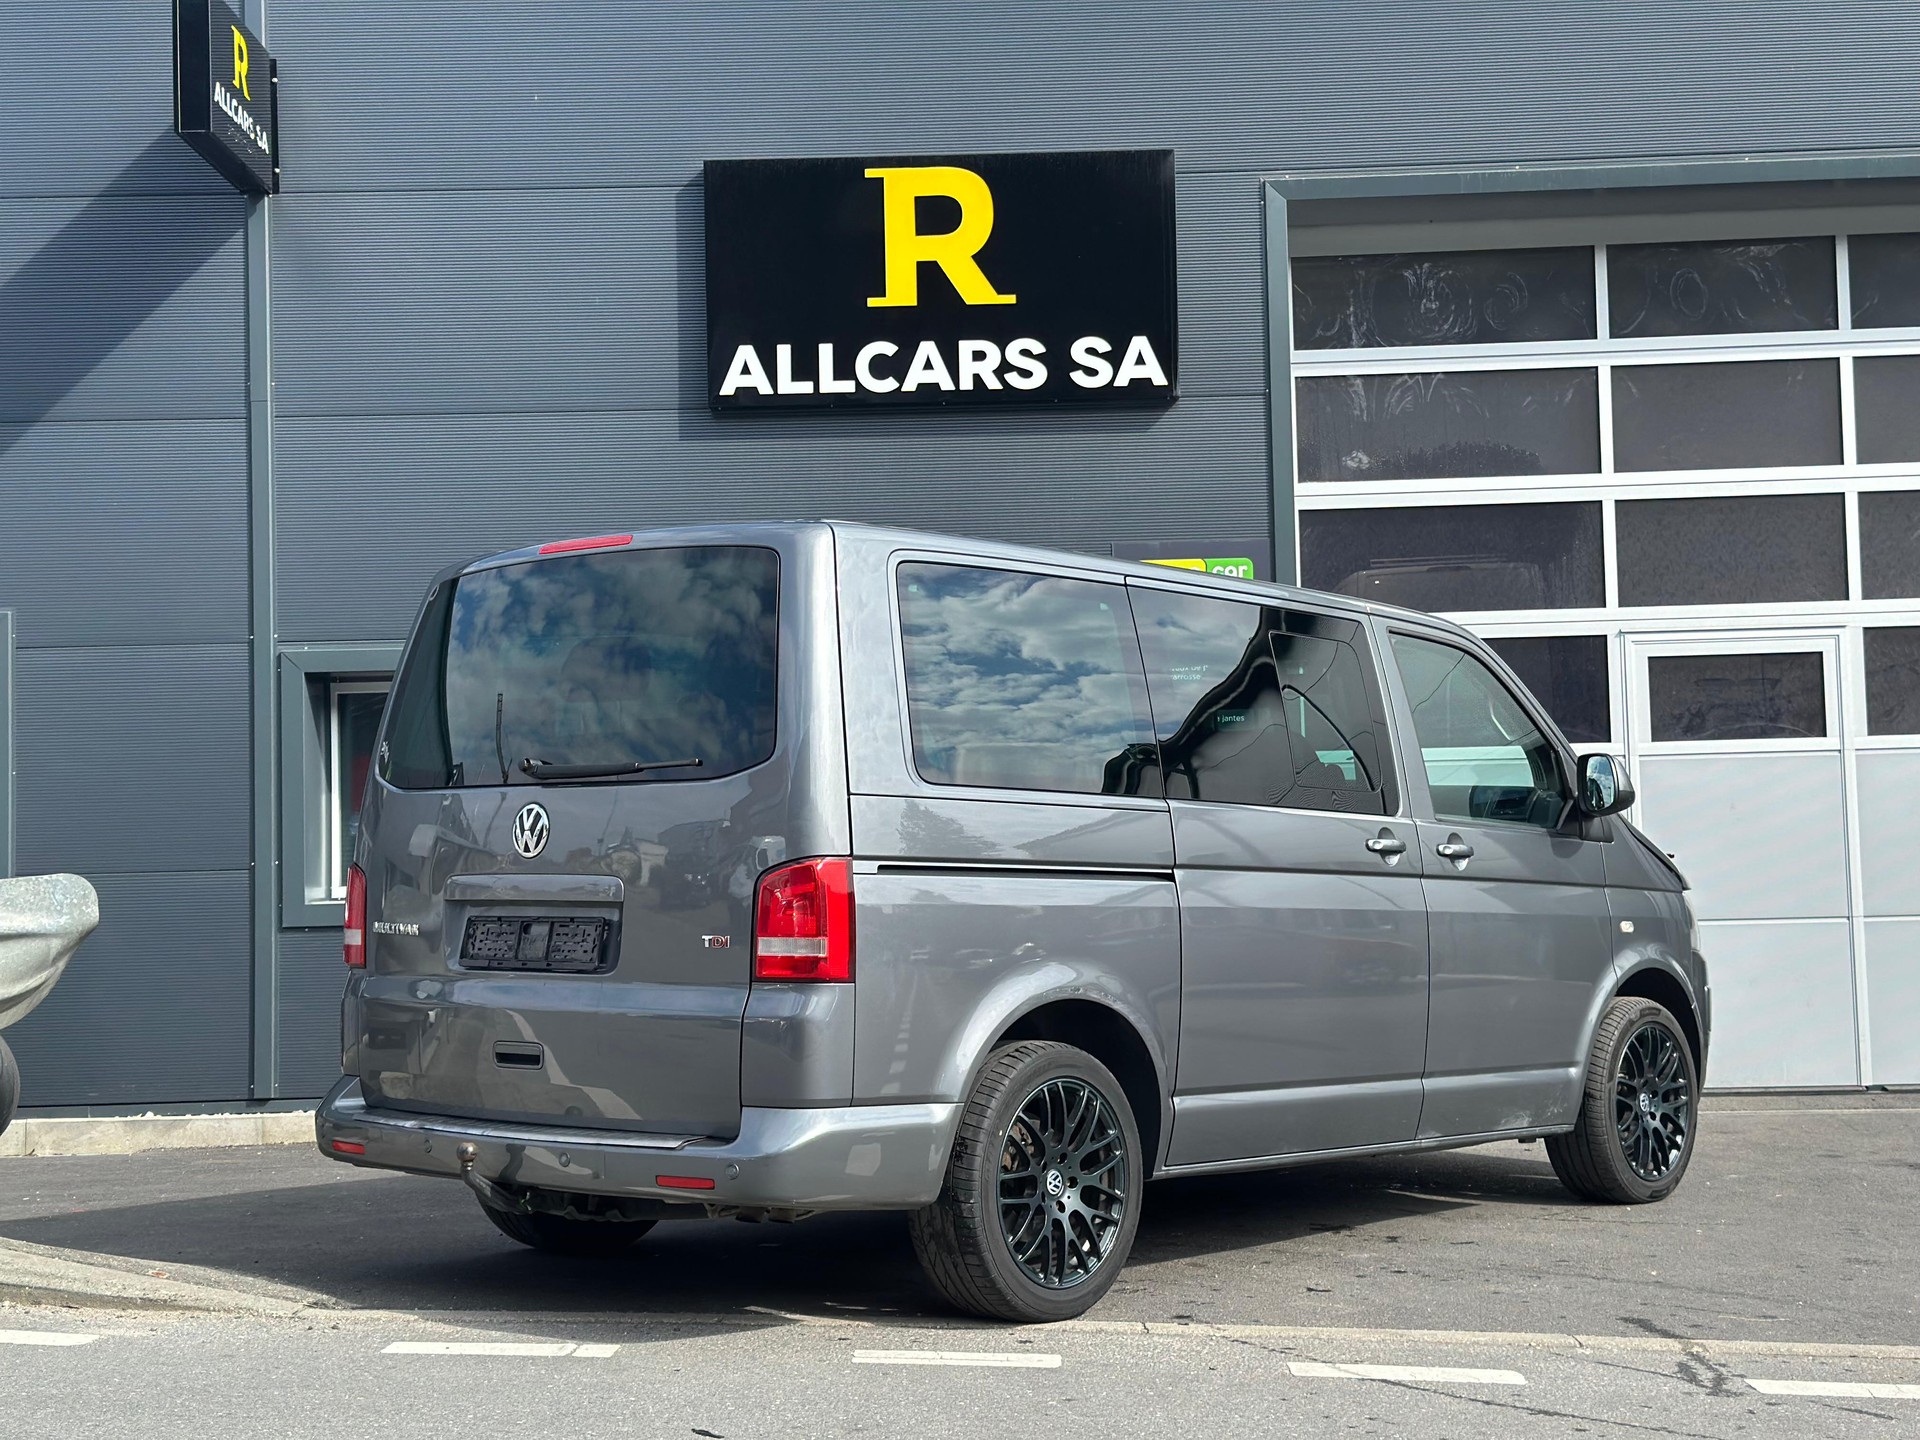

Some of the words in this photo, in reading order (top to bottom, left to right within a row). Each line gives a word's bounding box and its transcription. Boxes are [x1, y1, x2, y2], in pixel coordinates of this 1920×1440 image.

[231, 25, 250, 101] R
[214, 81, 255, 140] ALLCARS
[256, 125, 269, 154] SA
[864, 166, 1017, 307] R
[719, 337, 1048, 396] ALLCARS
[1069, 335, 1169, 388] SA
[701, 935, 730, 949] TDI
